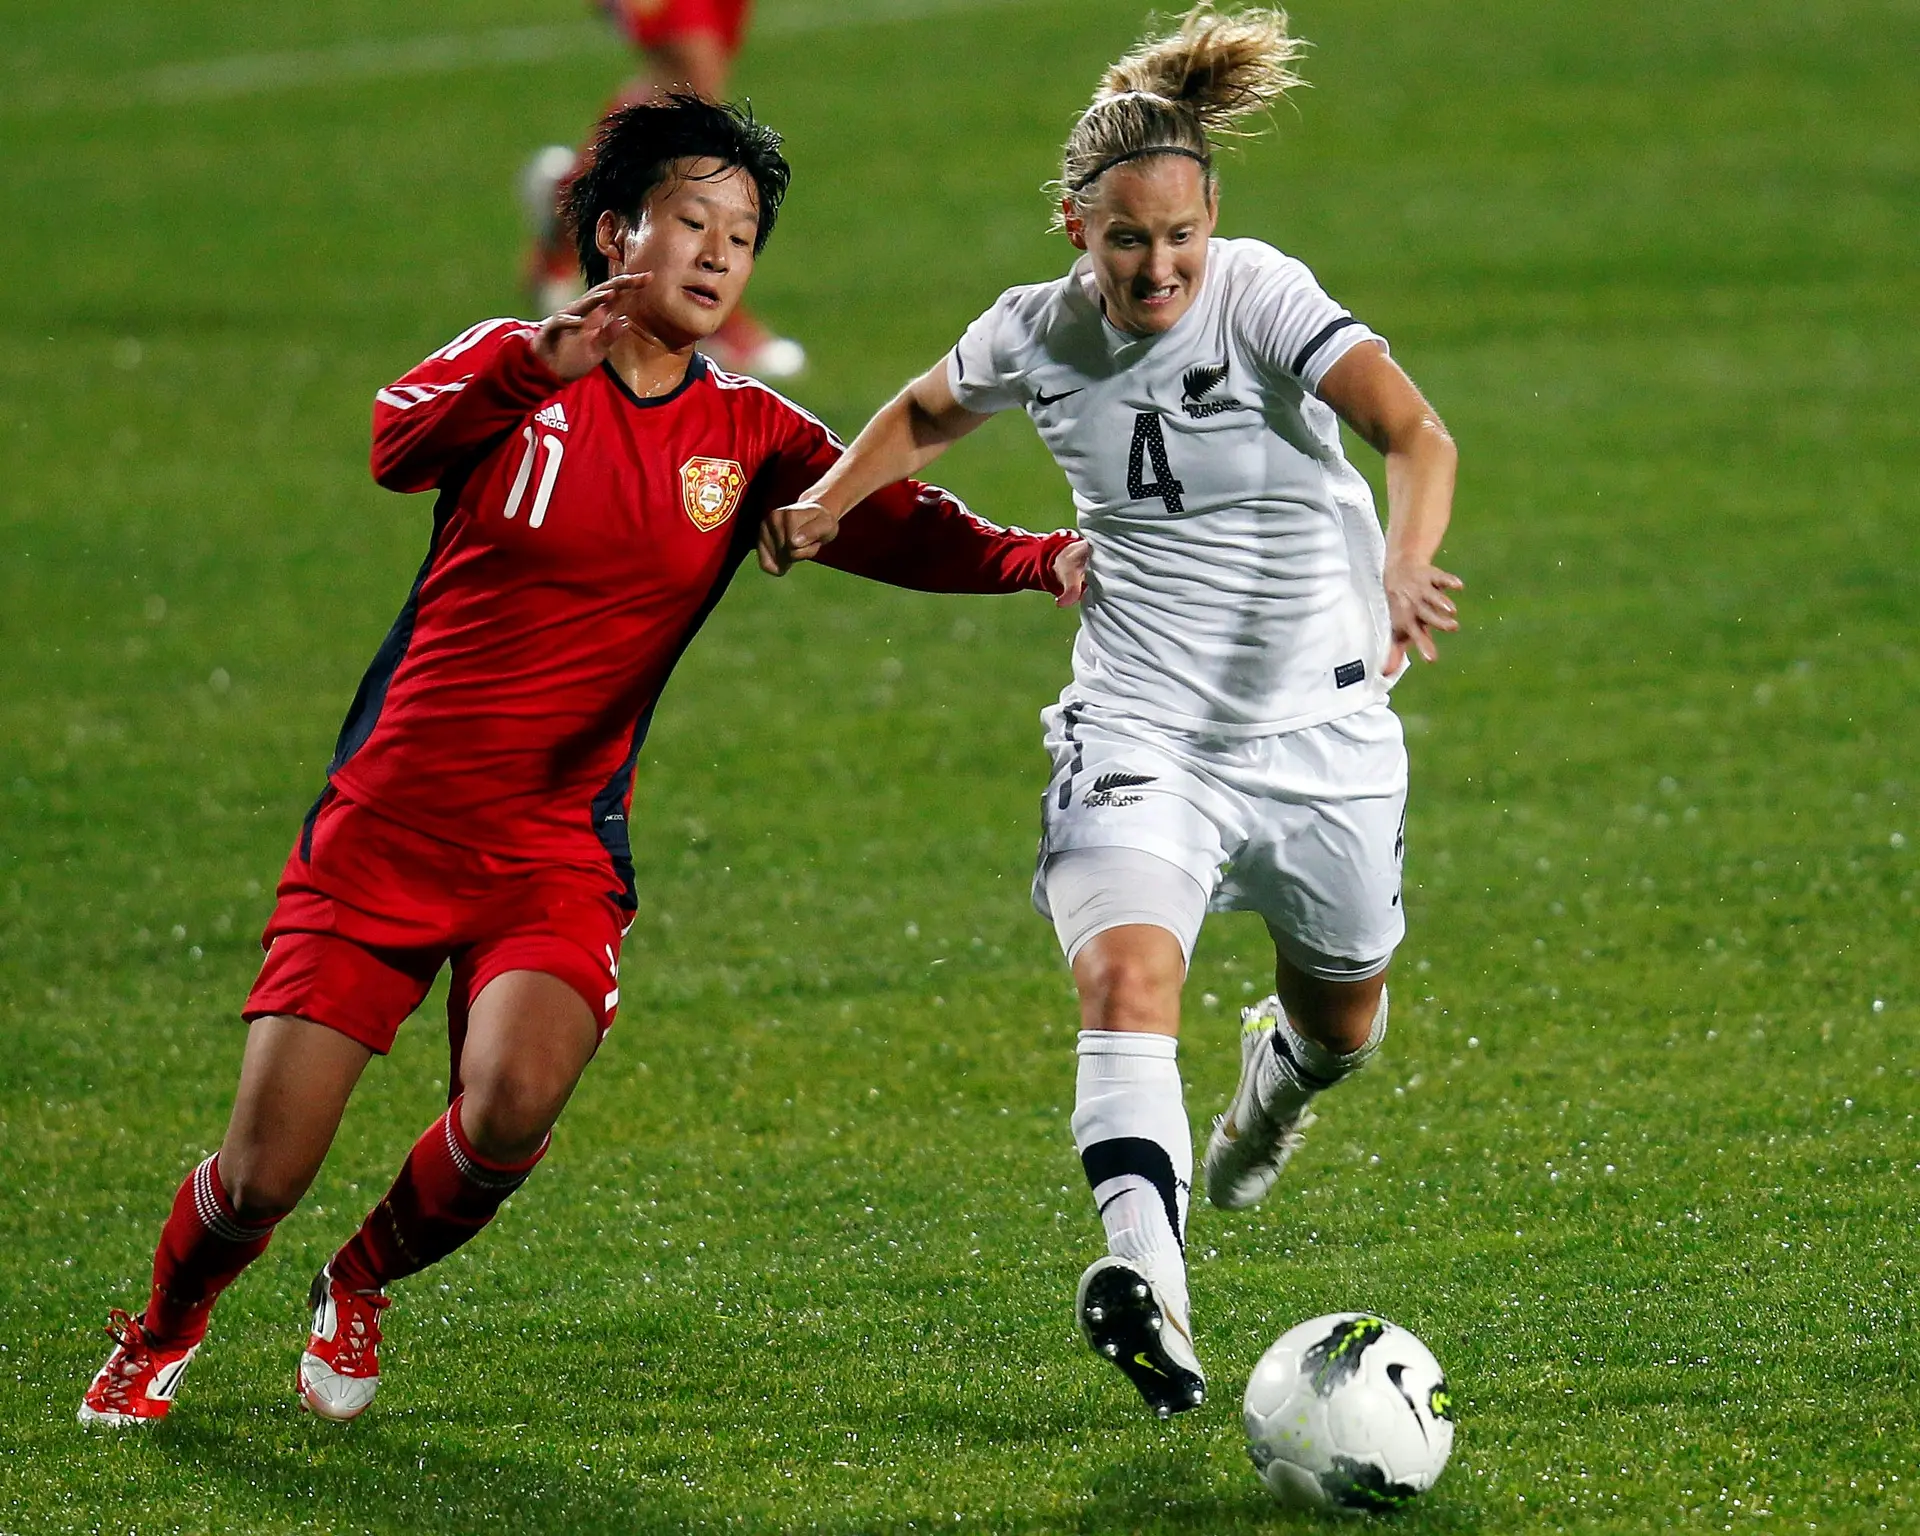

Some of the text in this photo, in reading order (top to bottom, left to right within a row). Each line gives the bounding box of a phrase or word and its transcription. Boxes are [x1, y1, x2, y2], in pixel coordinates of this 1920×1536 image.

[534, 413, 569, 432] adidas
[1127, 413, 1185, 514] 4
[503, 426, 564, 529] 11
